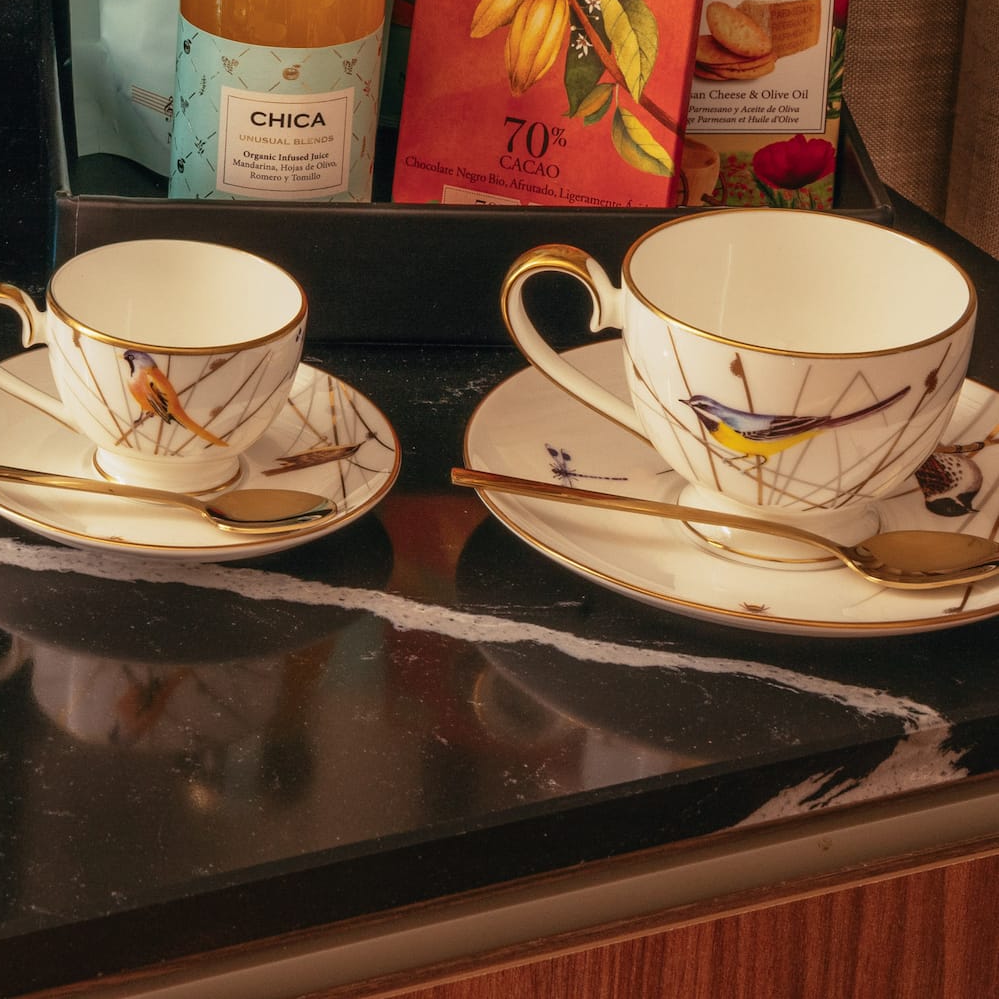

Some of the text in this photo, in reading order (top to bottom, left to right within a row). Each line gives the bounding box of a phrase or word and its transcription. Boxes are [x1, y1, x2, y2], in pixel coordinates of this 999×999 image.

[709, 89, 746, 100] Cheese
[749, 89, 759, 100] &
[761, 89, 790, 100] Olive
[792, 89, 809, 100] Oil
[689, 105, 800, 115] Parmesano y Aceite de Oliva
[250, 111, 326, 129] CHICA
[697, 115, 736, 124] Parmesan
[738, 115, 746, 124] et
[748, 115, 770, 124] Huile
[771, 115, 800, 124] d'Olive
[239, 134, 335, 146] UNUSUAL BLENDS
[503, 116, 568, 159] 70%
[243, 150, 329, 163] Organic Infused Juice
[232, 158, 279, 172] Mandarina,
[281, 164, 304, 173] Hojas
[316, 159, 338, 170] Olivo,
[499, 154, 560, 180] CACAO
[250, 172, 282, 182] Romero
[292, 172, 321, 182] Tomillo
[404, 155, 454, 176] Chocolate
[456, 166, 487, 184] Negro
[488, 173, 508, 187] Bio,
[509, 178, 558, 198] Afrutado,
